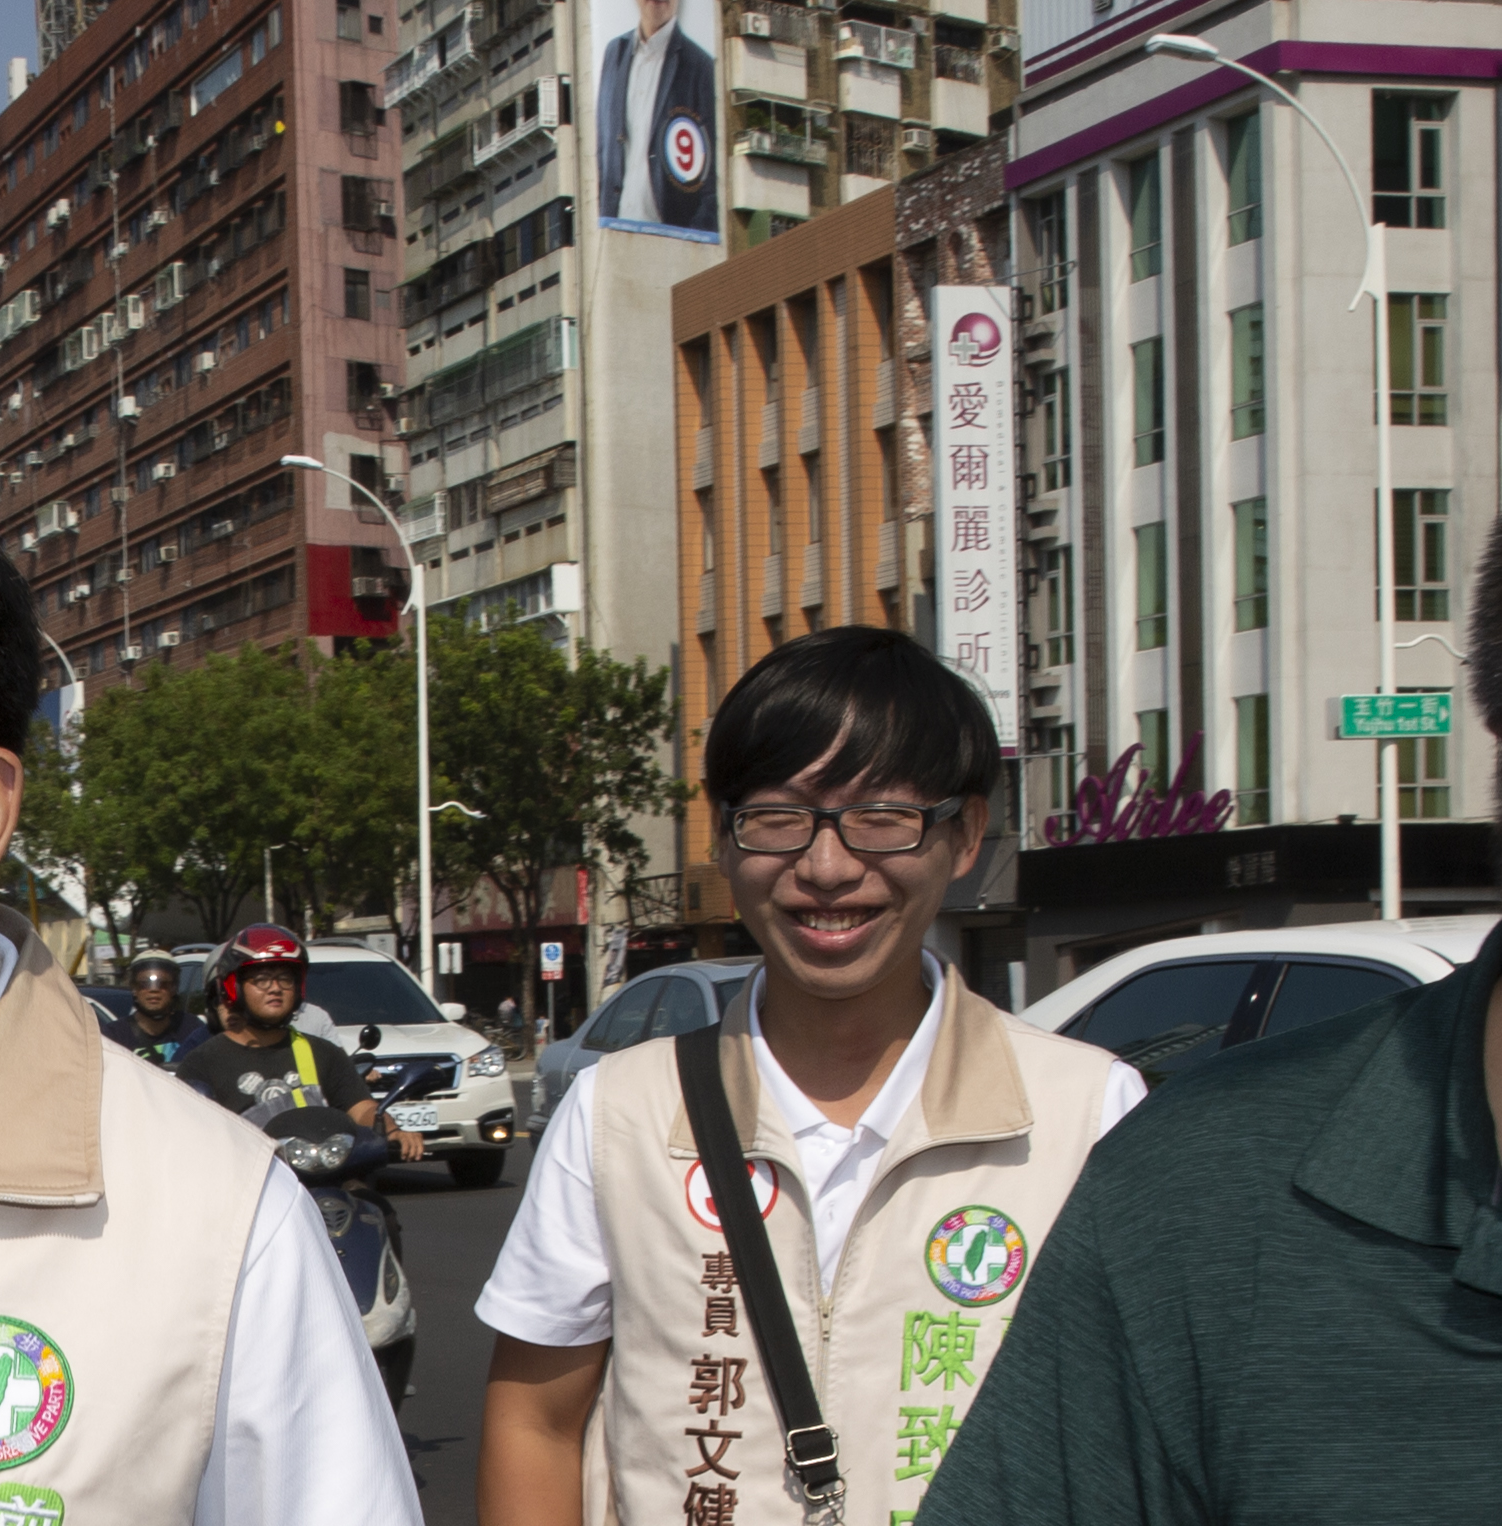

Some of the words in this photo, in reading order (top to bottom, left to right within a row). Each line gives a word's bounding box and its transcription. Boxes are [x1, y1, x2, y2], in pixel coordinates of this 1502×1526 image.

[675, 128, 694, 172] 9
[948, 382, 992, 674] 愛爾麗診所
[45, 1379, 64, 1424] PARTY
